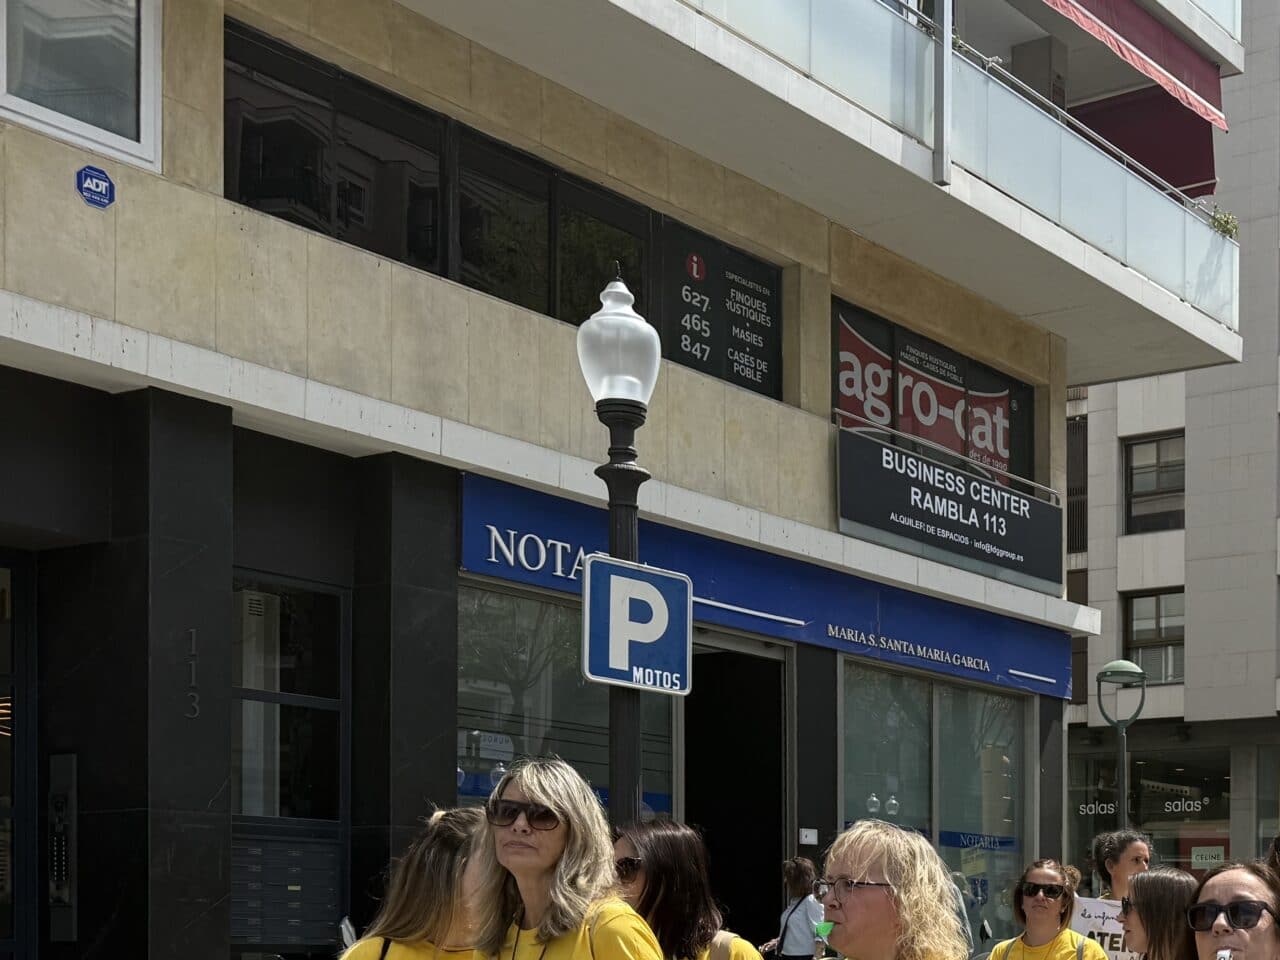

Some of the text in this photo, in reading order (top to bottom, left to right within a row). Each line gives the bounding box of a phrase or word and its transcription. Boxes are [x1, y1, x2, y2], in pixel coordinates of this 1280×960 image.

[83, 177, 109, 195] ADT
[681, 285, 710, 312] 627
[730, 288, 768, 313] FINQUES
[681, 313, 711, 337] 465
[732, 325, 764, 348] MASIES
[680, 334, 711, 361] 847
[727, 348, 769, 373] CASES DE
[733, 362, 762, 382] POBLE
[882, 447, 1031, 519] BUSINESS CENTER
[910, 486, 1006, 537] RAMBLA 113
[926, 525, 936, 535] DE
[936, 526, 969, 545] ESPACIOS
[609, 574, 669, 671] P
[827, 624, 991, 672] MARIA S. SANTA MARIA GARCIA
[632, 666, 681, 690] MOTOS
[1079, 801, 1115, 815] salas
[1164, 798, 1202, 813] salas
[960, 834, 999, 849] NOTARIA
